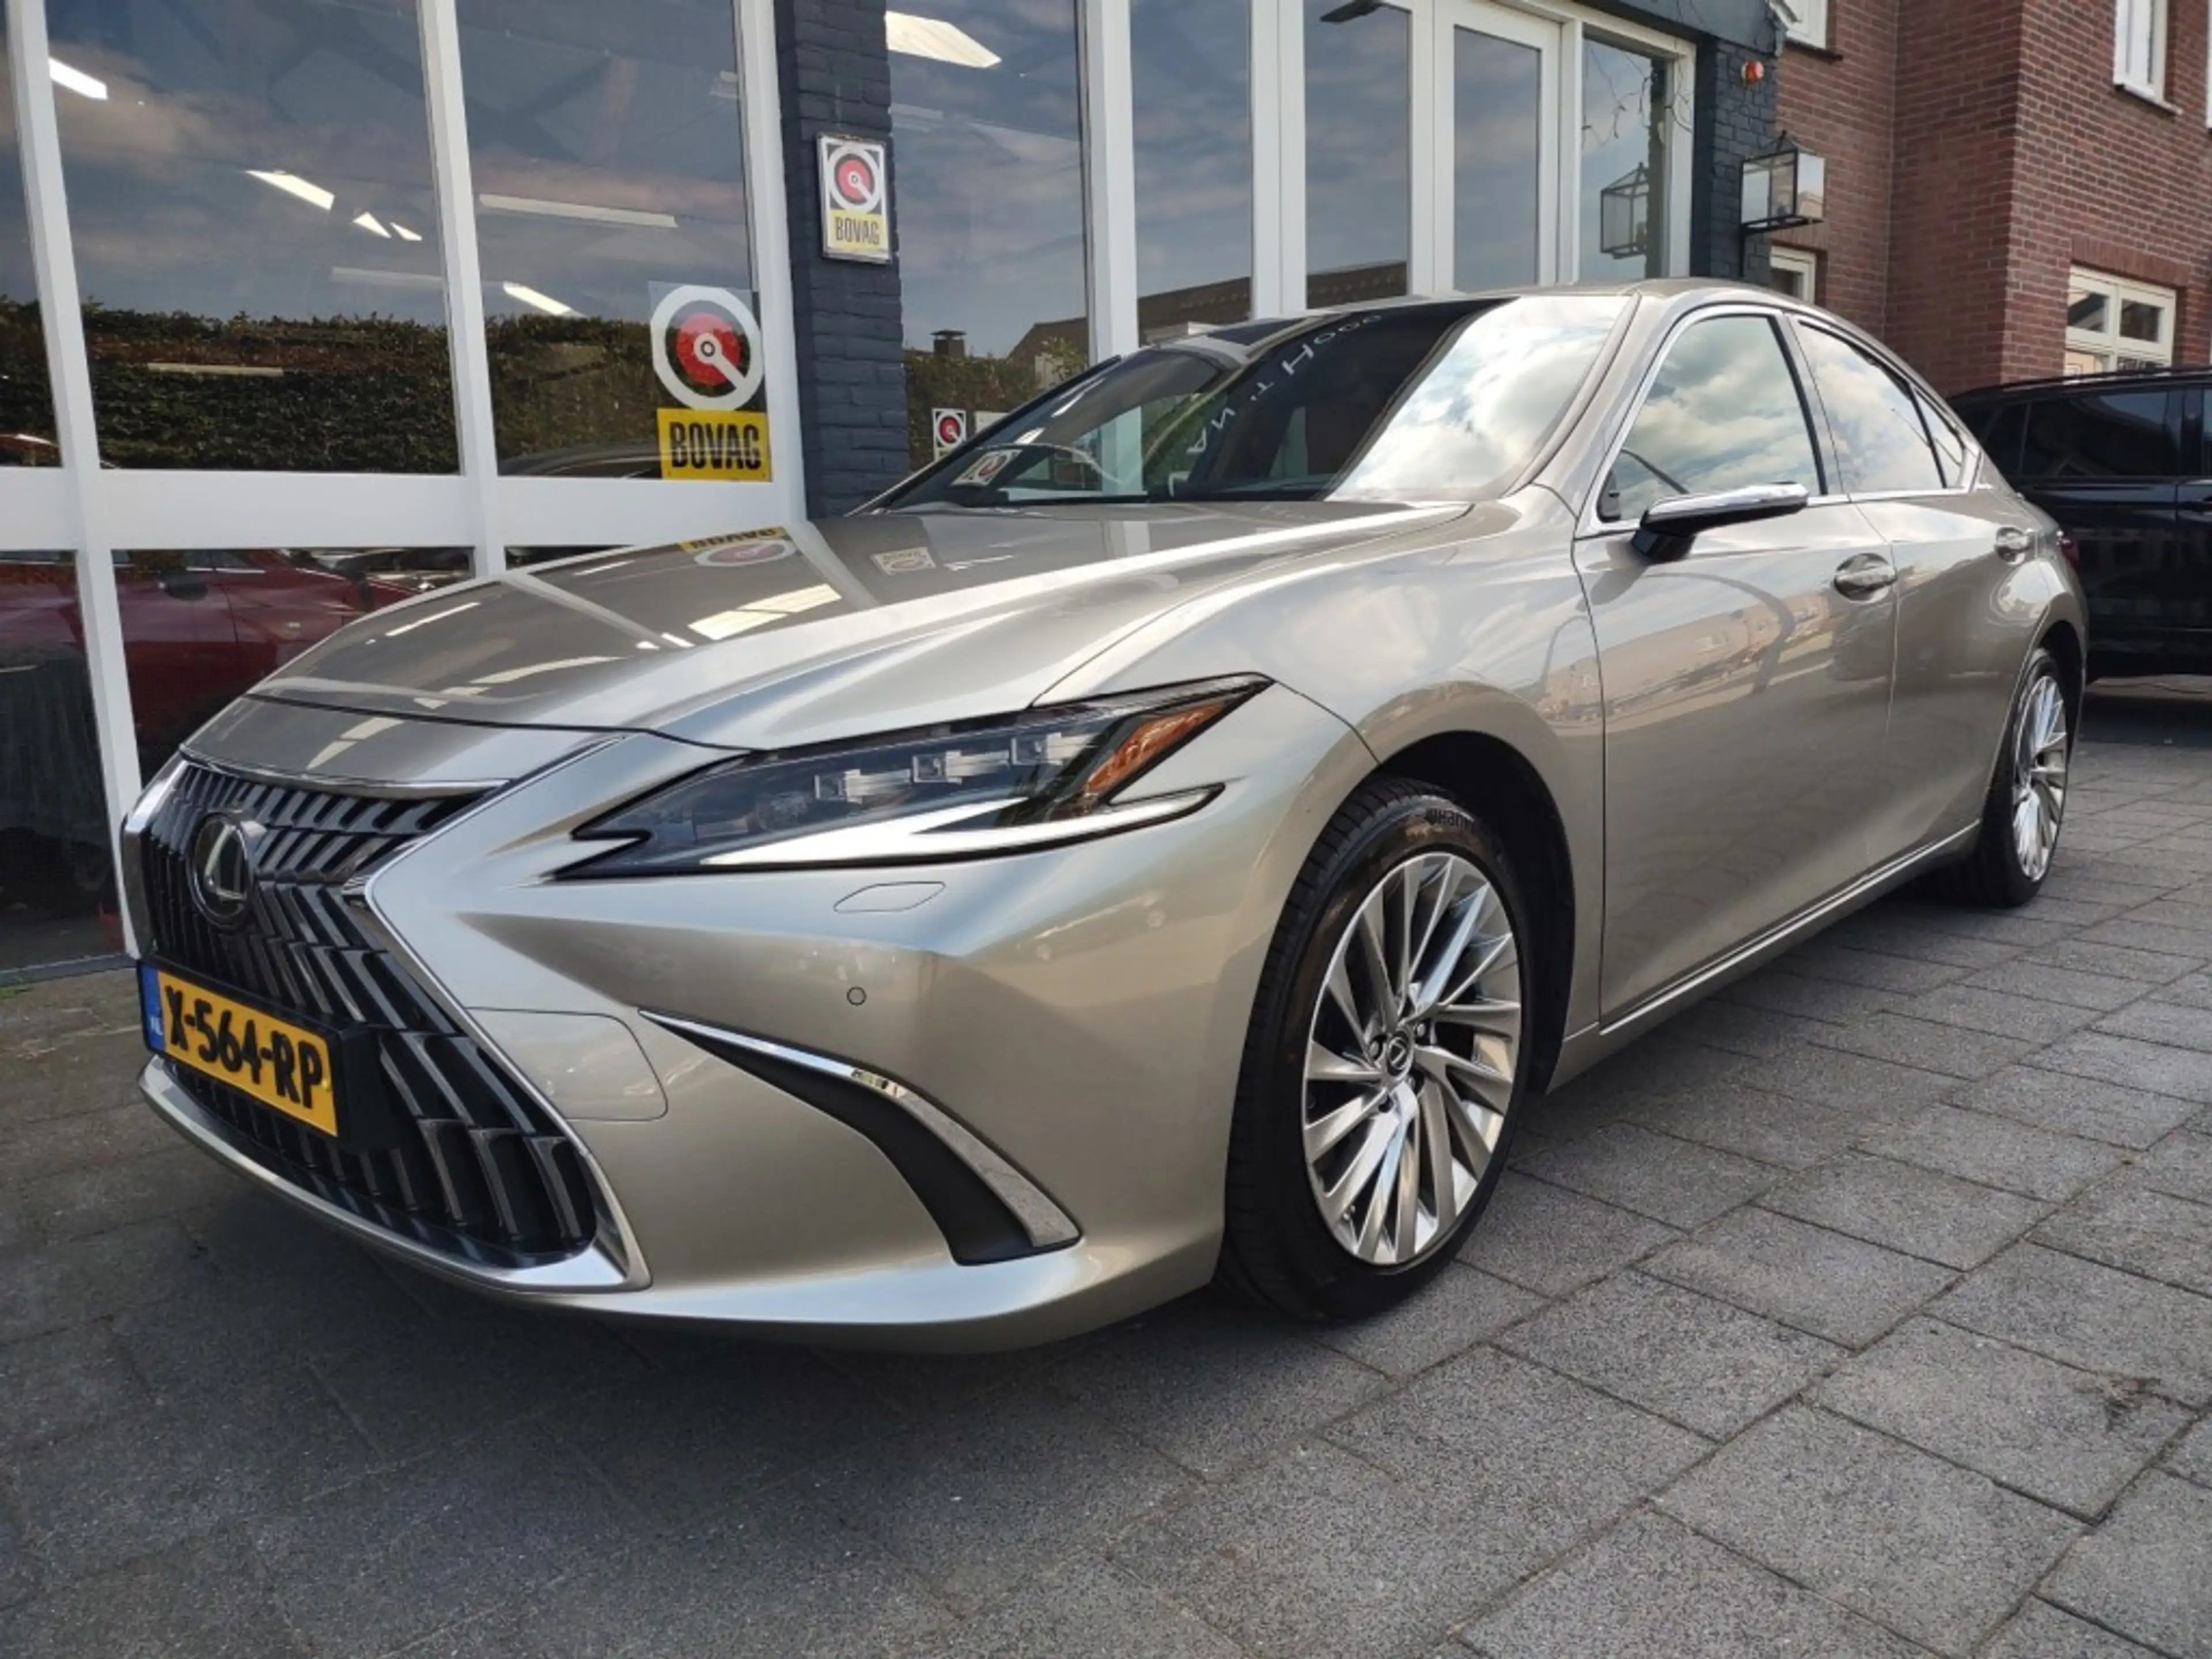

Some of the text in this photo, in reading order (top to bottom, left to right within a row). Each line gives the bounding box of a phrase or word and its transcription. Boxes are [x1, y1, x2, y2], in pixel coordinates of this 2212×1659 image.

[834, 216, 880, 245] BOVAG
[669, 421, 762, 471] BOVAG
[150, 1014, 164, 1036] NL
[164, 985, 323, 1109] X-564-RP
